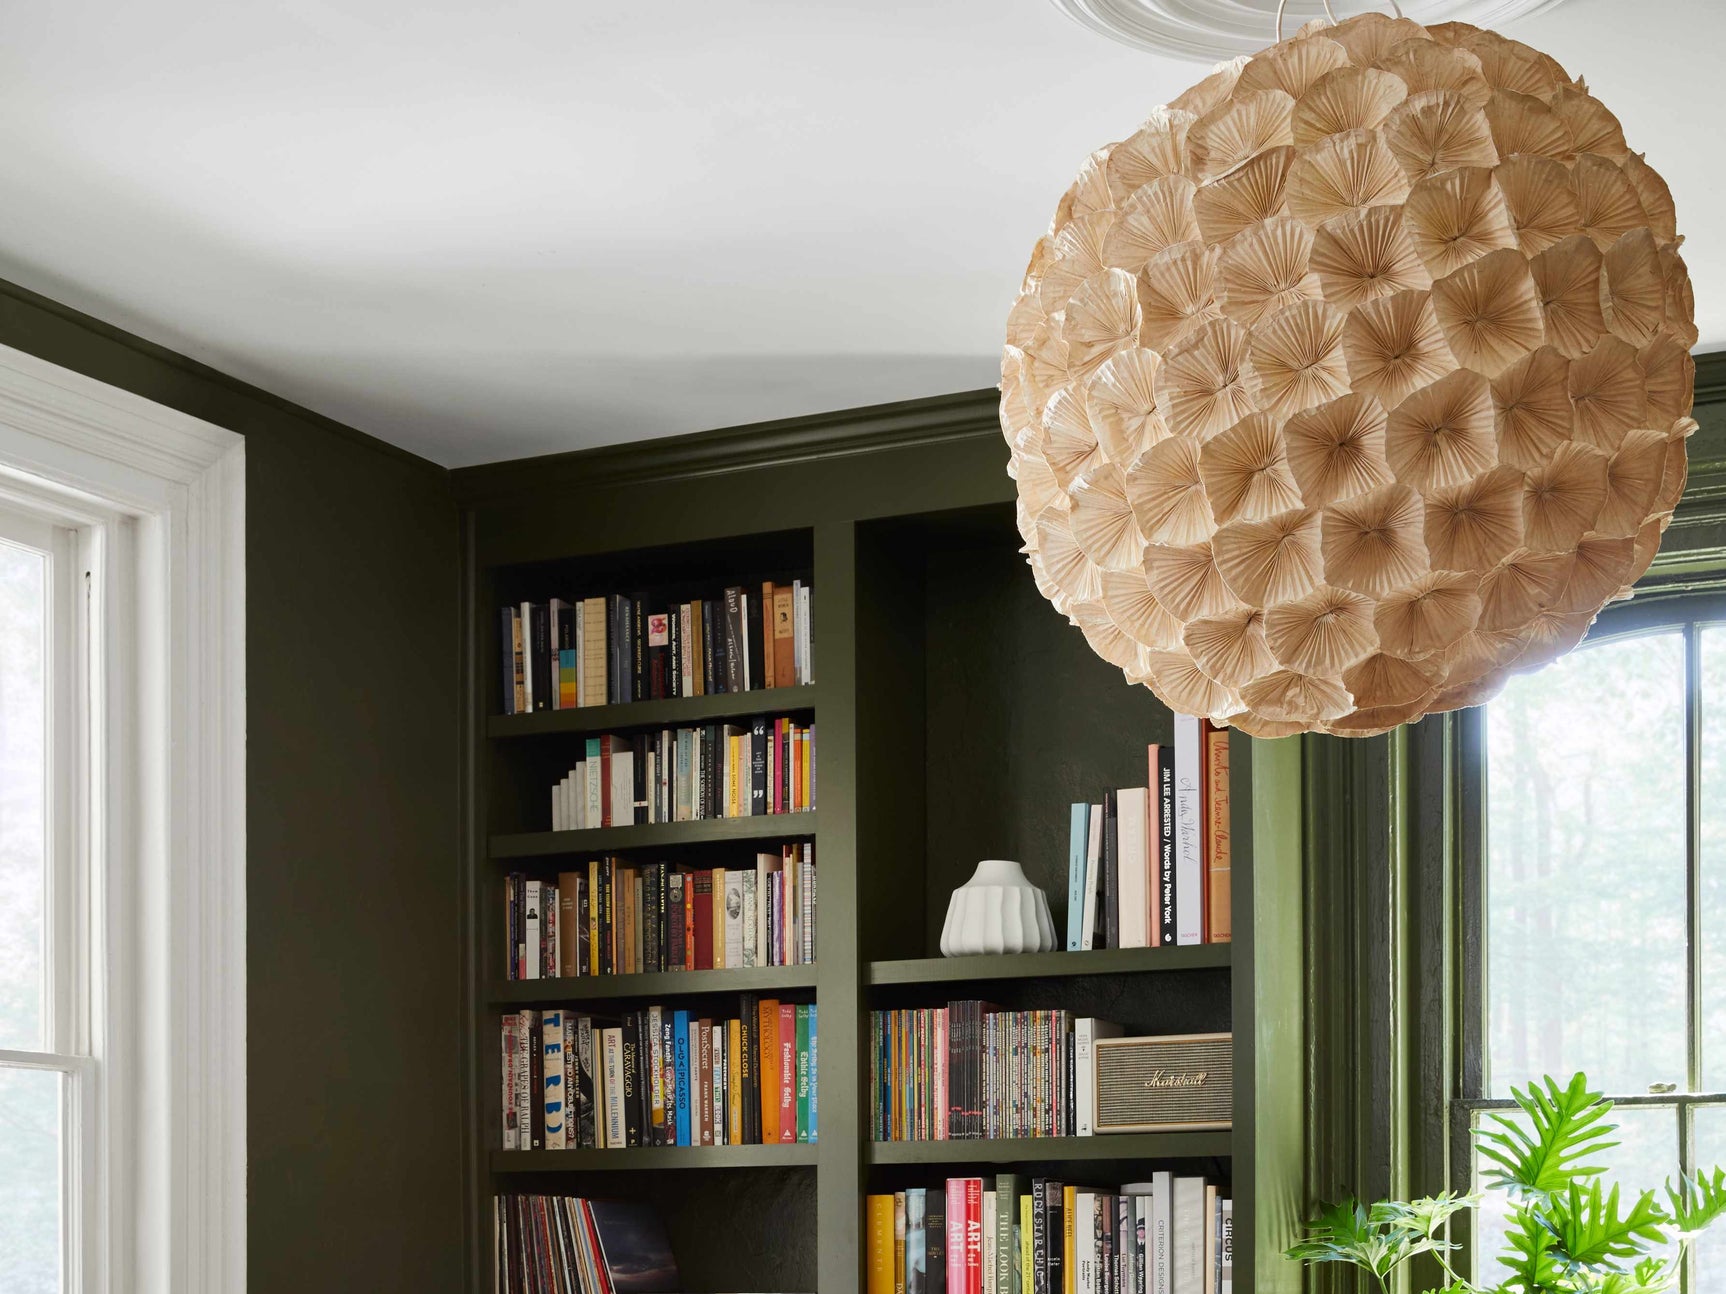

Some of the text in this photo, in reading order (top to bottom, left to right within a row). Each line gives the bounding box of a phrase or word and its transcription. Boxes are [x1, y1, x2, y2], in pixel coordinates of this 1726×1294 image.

[1163, 767, 1171, 783] JIM
[1163, 784, 1171, 796] LEE
[1163, 797, 1171, 836] ARRESTED
[1163, 844, 1171, 869] Words
[1163, 870, 1171, 882] by
[1163, 883, 1171, 905] Peter
[1163, 905, 1171, 924] York
[1034, 1183, 1043, 1214] ROCK
[950, 1221, 963, 1252] ART
[967, 1220, 981, 1252] ART
[999, 1212, 1009, 1242] THE
[1035, 1218, 1043, 1246] STAR
[1225, 1218, 1233, 1261] CIRCUS
[999, 1246, 1009, 1281] LOOK
